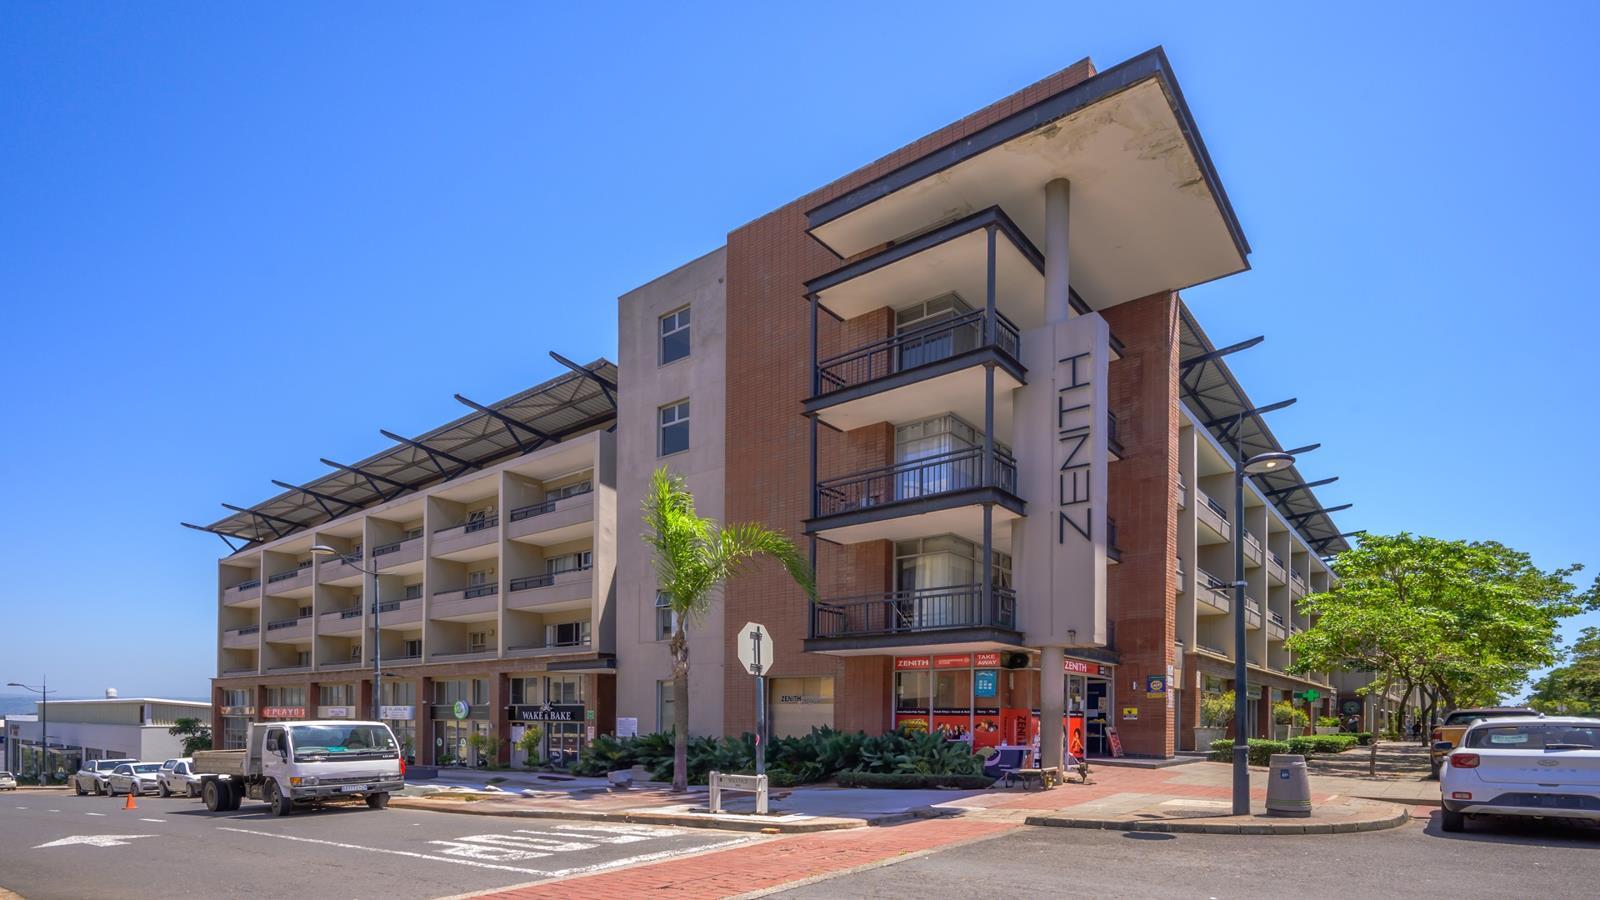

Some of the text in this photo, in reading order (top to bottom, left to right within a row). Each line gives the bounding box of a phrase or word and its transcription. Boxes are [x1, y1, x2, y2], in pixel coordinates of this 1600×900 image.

[1058, 352, 1091, 544] ZENITH
[897, 659, 929, 667] ZENITH
[1064, 660, 1087, 673] ZENITH
[522, 711, 544, 720] WAKE
[550, 711, 572, 720] BAKE
